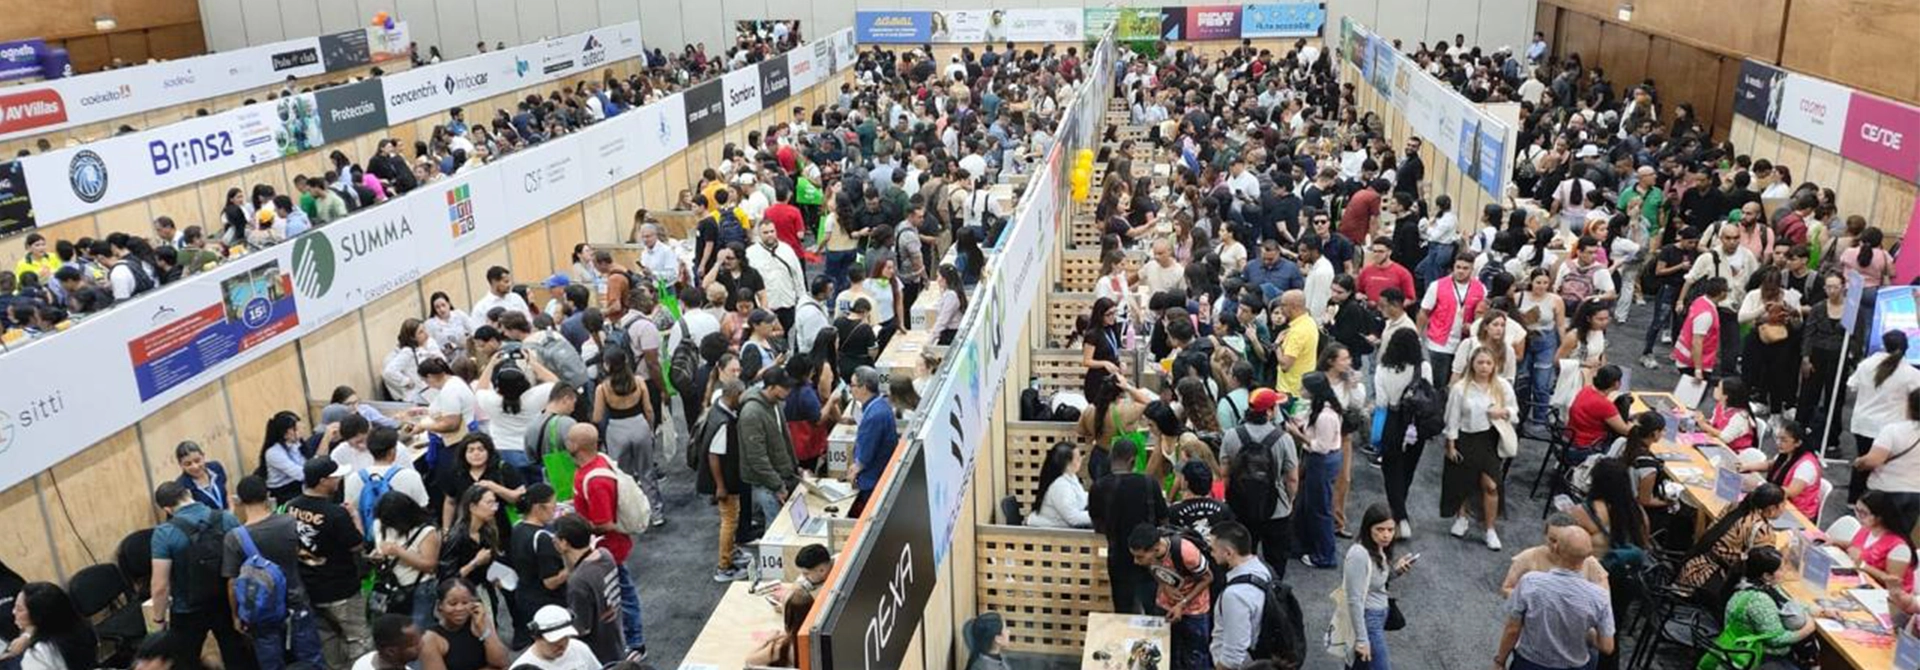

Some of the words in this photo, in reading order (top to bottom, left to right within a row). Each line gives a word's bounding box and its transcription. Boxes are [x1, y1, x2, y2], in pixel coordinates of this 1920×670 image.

[390, 80, 437, 107] concentrix
[6, 104, 25, 121] AV
[24, 100, 59, 118] Villas
[331, 100, 376, 122] Protección
[149, 131, 234, 176] Brinsa
[341, 215, 413, 262] SUMMA
[19, 390, 64, 428] sitti
[828, 450, 847, 463] 105
[762, 555, 783, 569] 104
